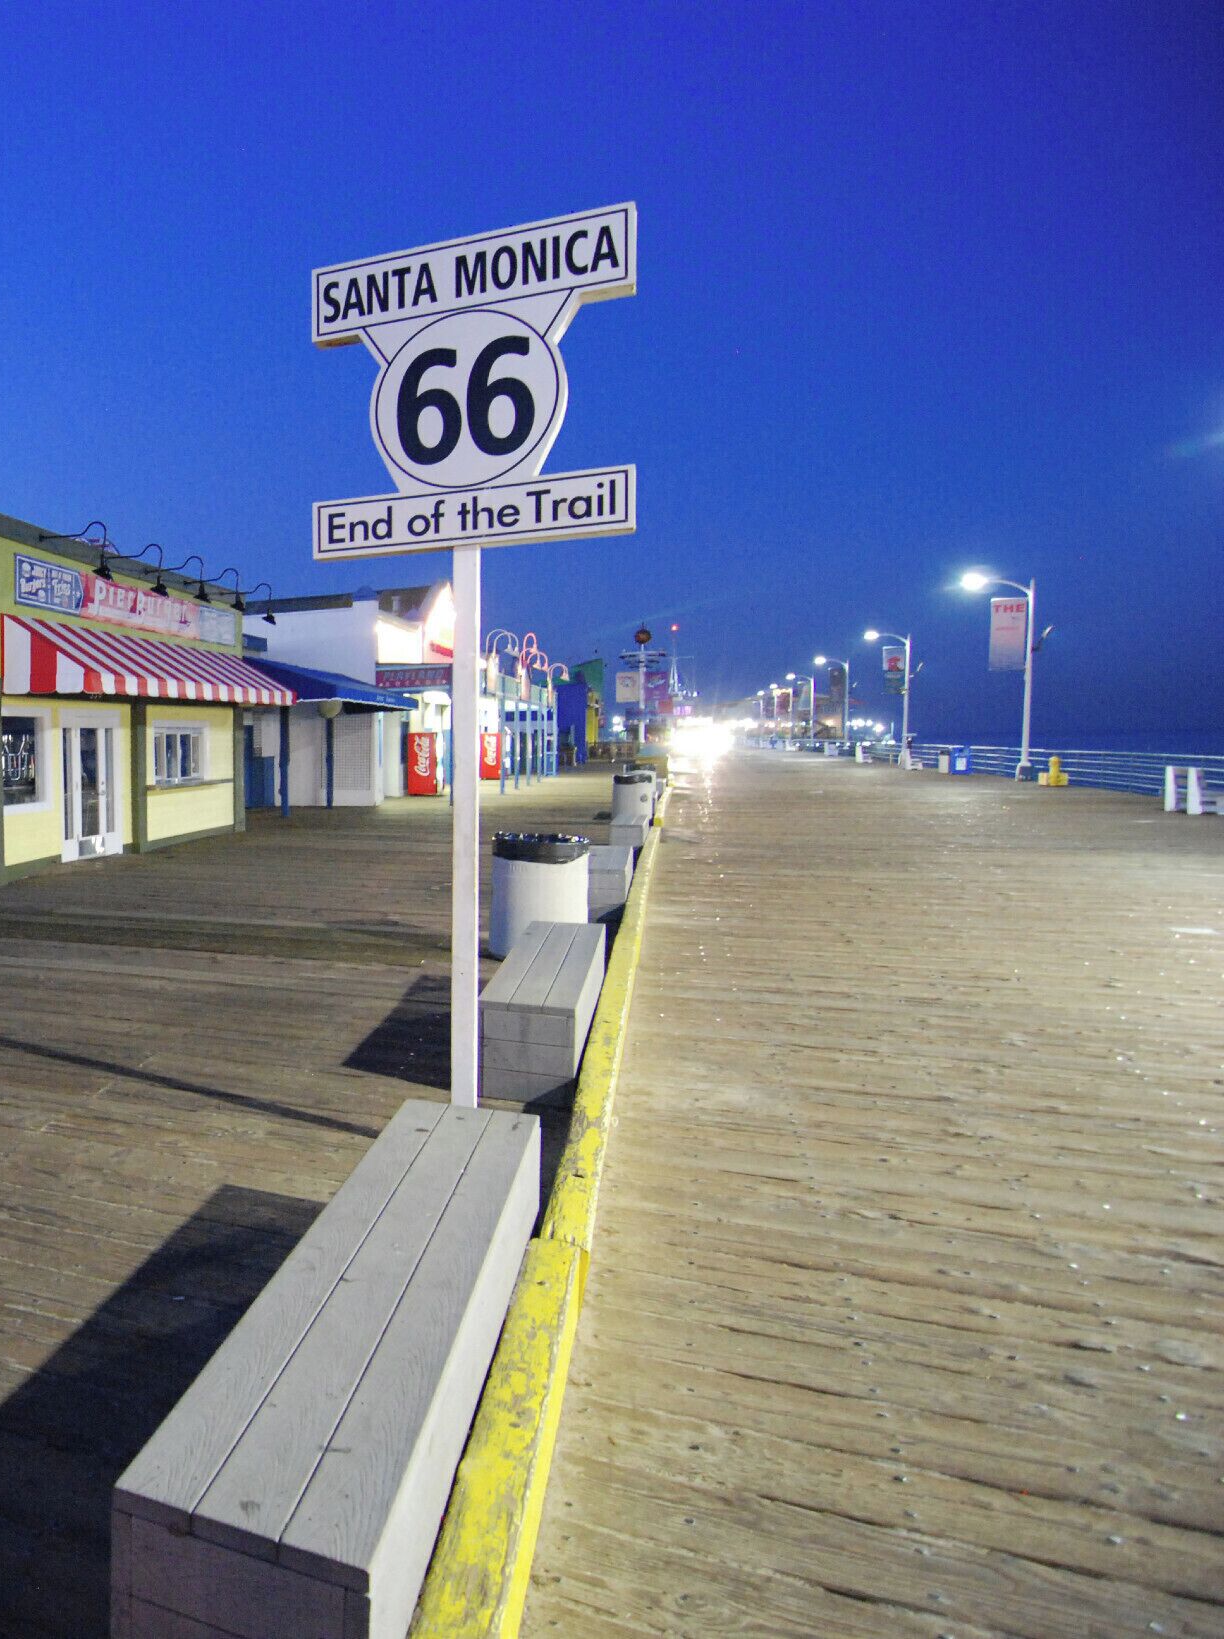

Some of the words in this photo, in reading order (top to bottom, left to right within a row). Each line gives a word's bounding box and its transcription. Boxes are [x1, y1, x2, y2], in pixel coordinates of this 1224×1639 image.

[323, 262, 438, 323] SANTA
[455, 225, 620, 299] MONICA
[397, 335, 535, 466] 66
[327, 505, 393, 544] End
[407, 499, 445, 537] of
[457, 495, 520, 531] the
[526, 478, 617, 524] Trail
[993, 603, 1025, 613] THE
